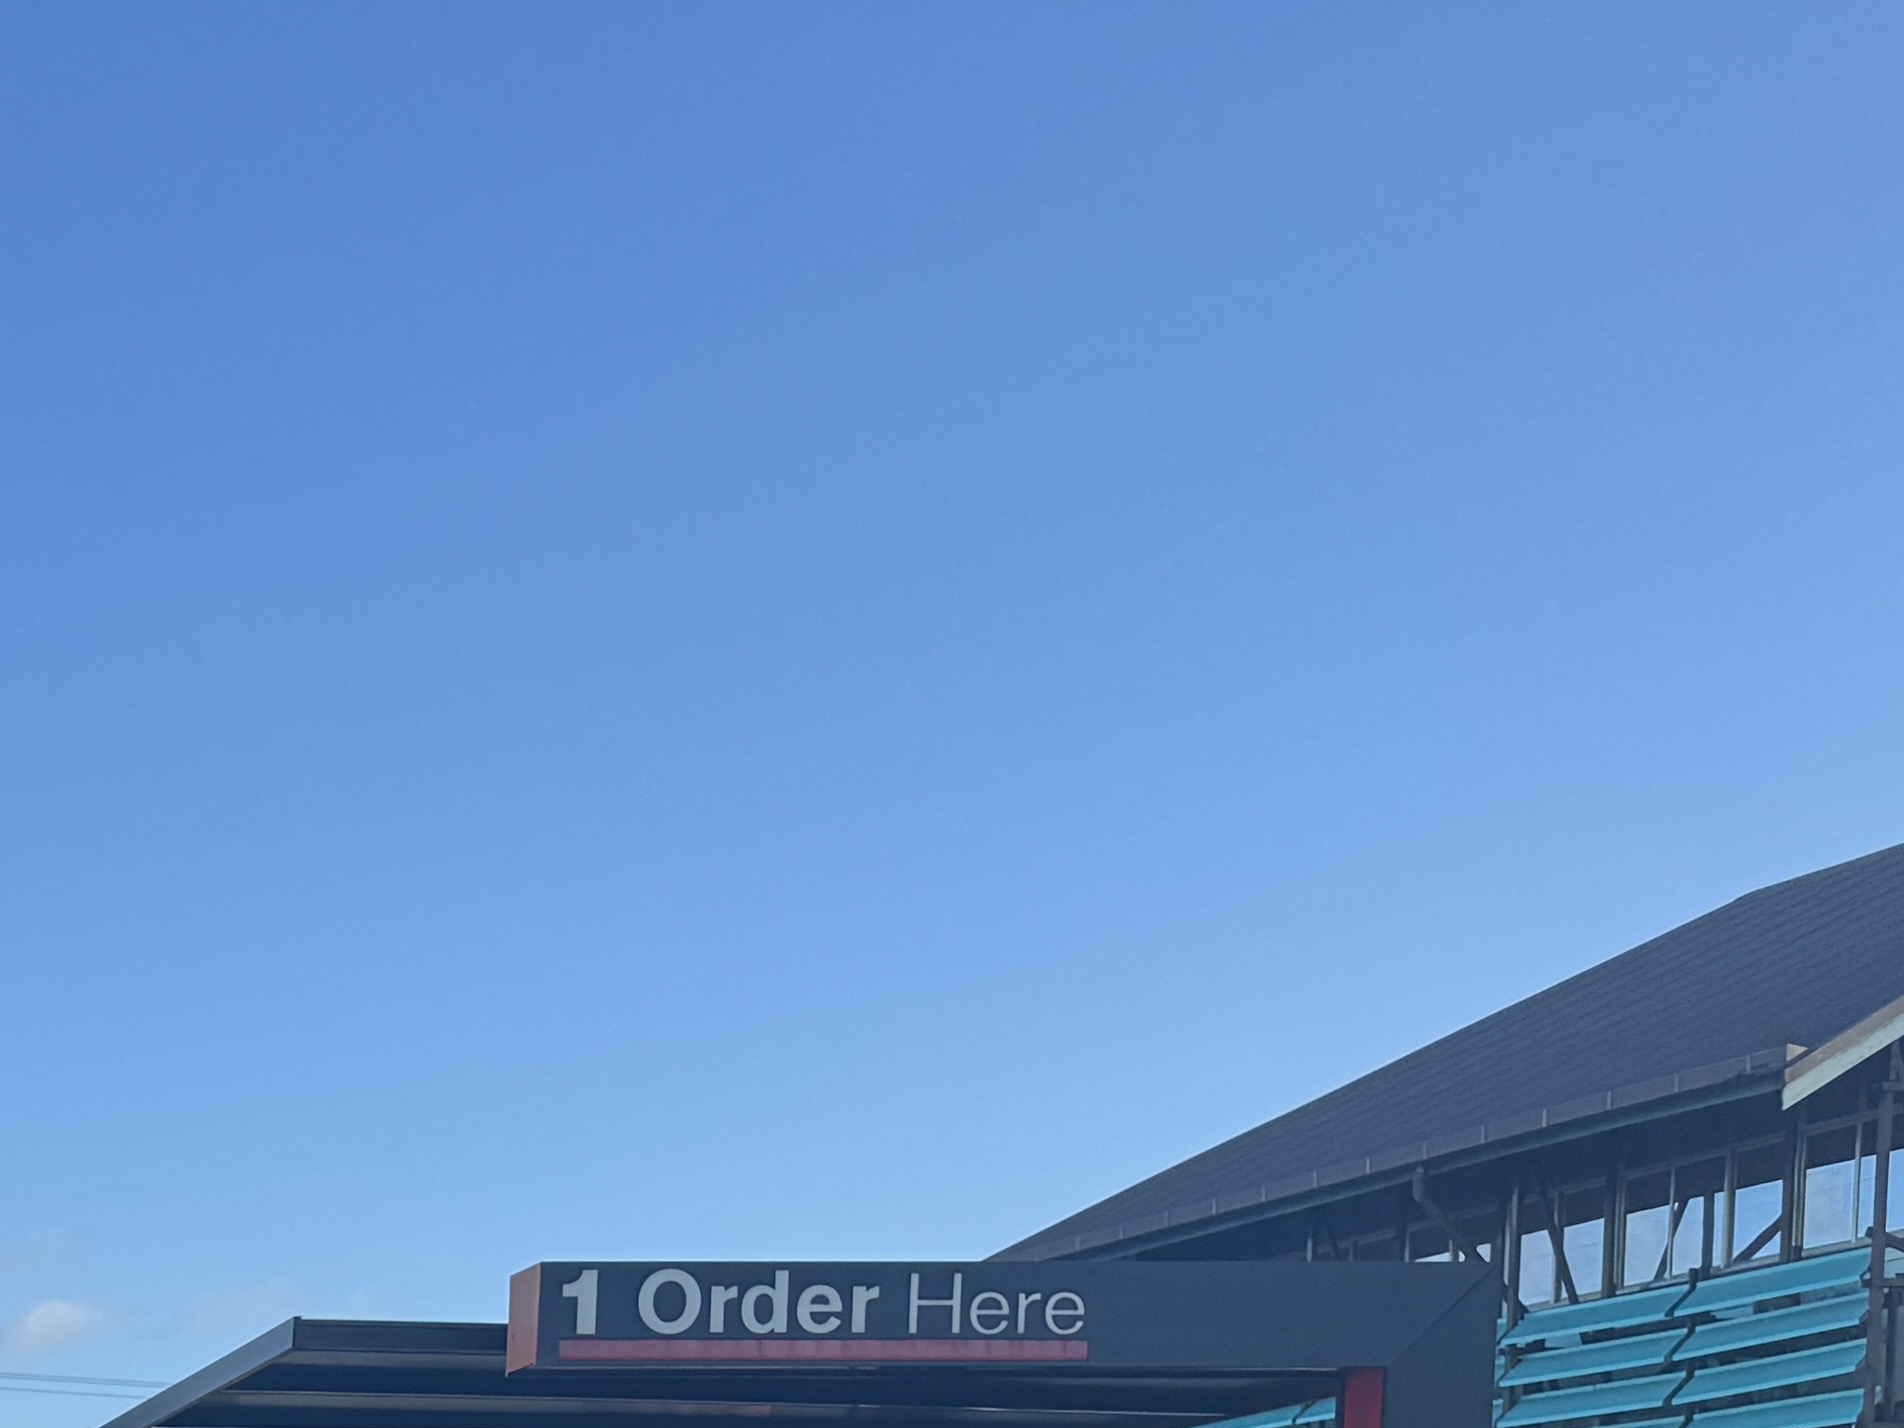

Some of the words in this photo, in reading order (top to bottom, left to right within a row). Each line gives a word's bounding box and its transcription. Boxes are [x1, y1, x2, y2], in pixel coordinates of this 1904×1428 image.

[562, 1269, 599, 1335] 1
[637, 1268, 880, 1335] Order
[909, 1272, 1085, 1335] Here
